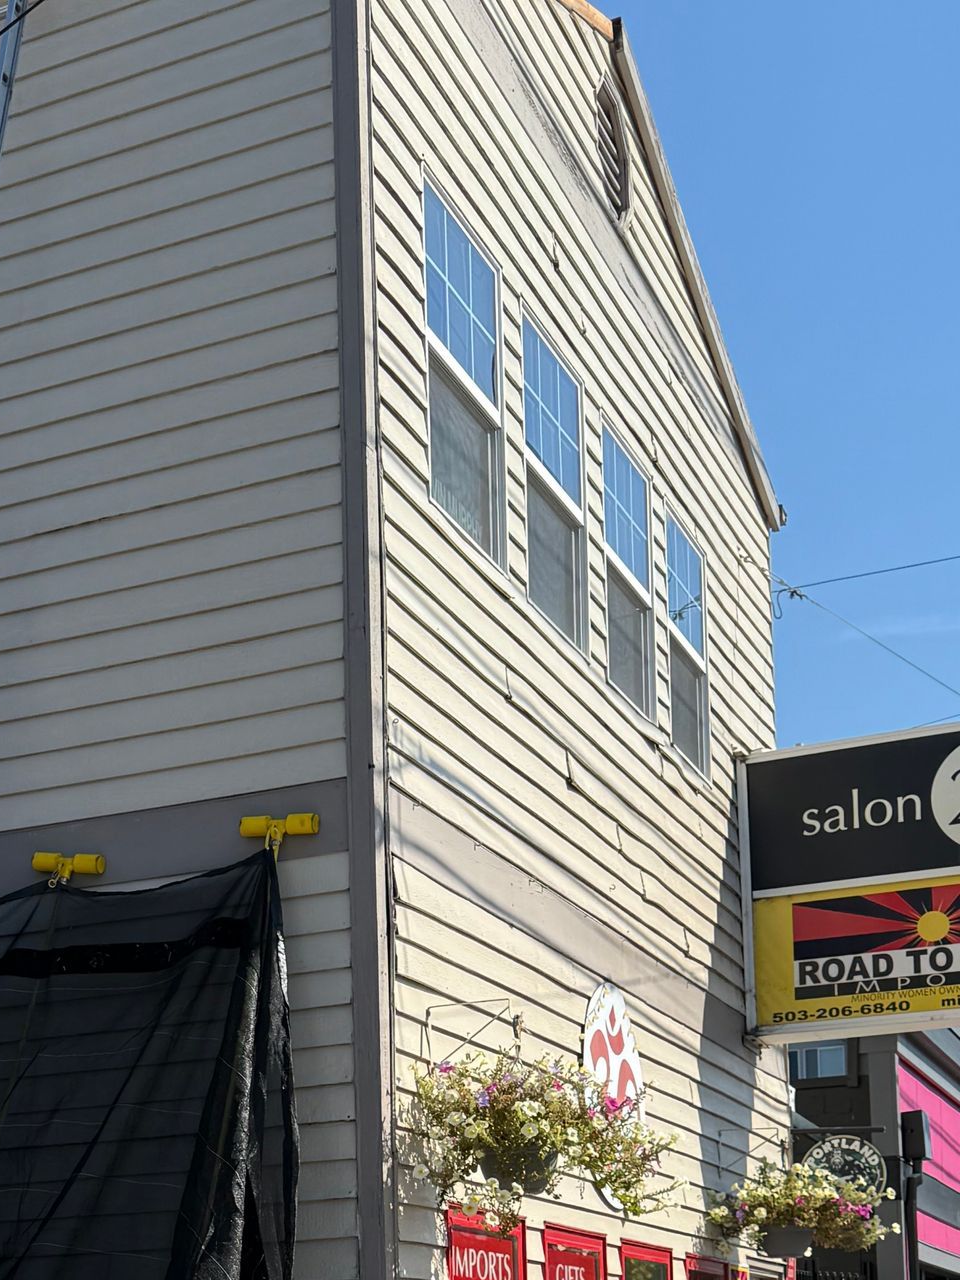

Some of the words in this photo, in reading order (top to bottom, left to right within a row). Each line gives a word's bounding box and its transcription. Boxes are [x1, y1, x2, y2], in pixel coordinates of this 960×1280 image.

[802, 788, 922, 837] salon
[799, 953, 894, 986] ROAD
[906, 947, 954, 974] TO
[851, 991, 896, 1004] MINORITY
[898, 987, 937, 1000] WOMEN
[772, 1000, 911, 1024] 503-206-6840
[806, 1138, 880, 1168] PORTLAND
